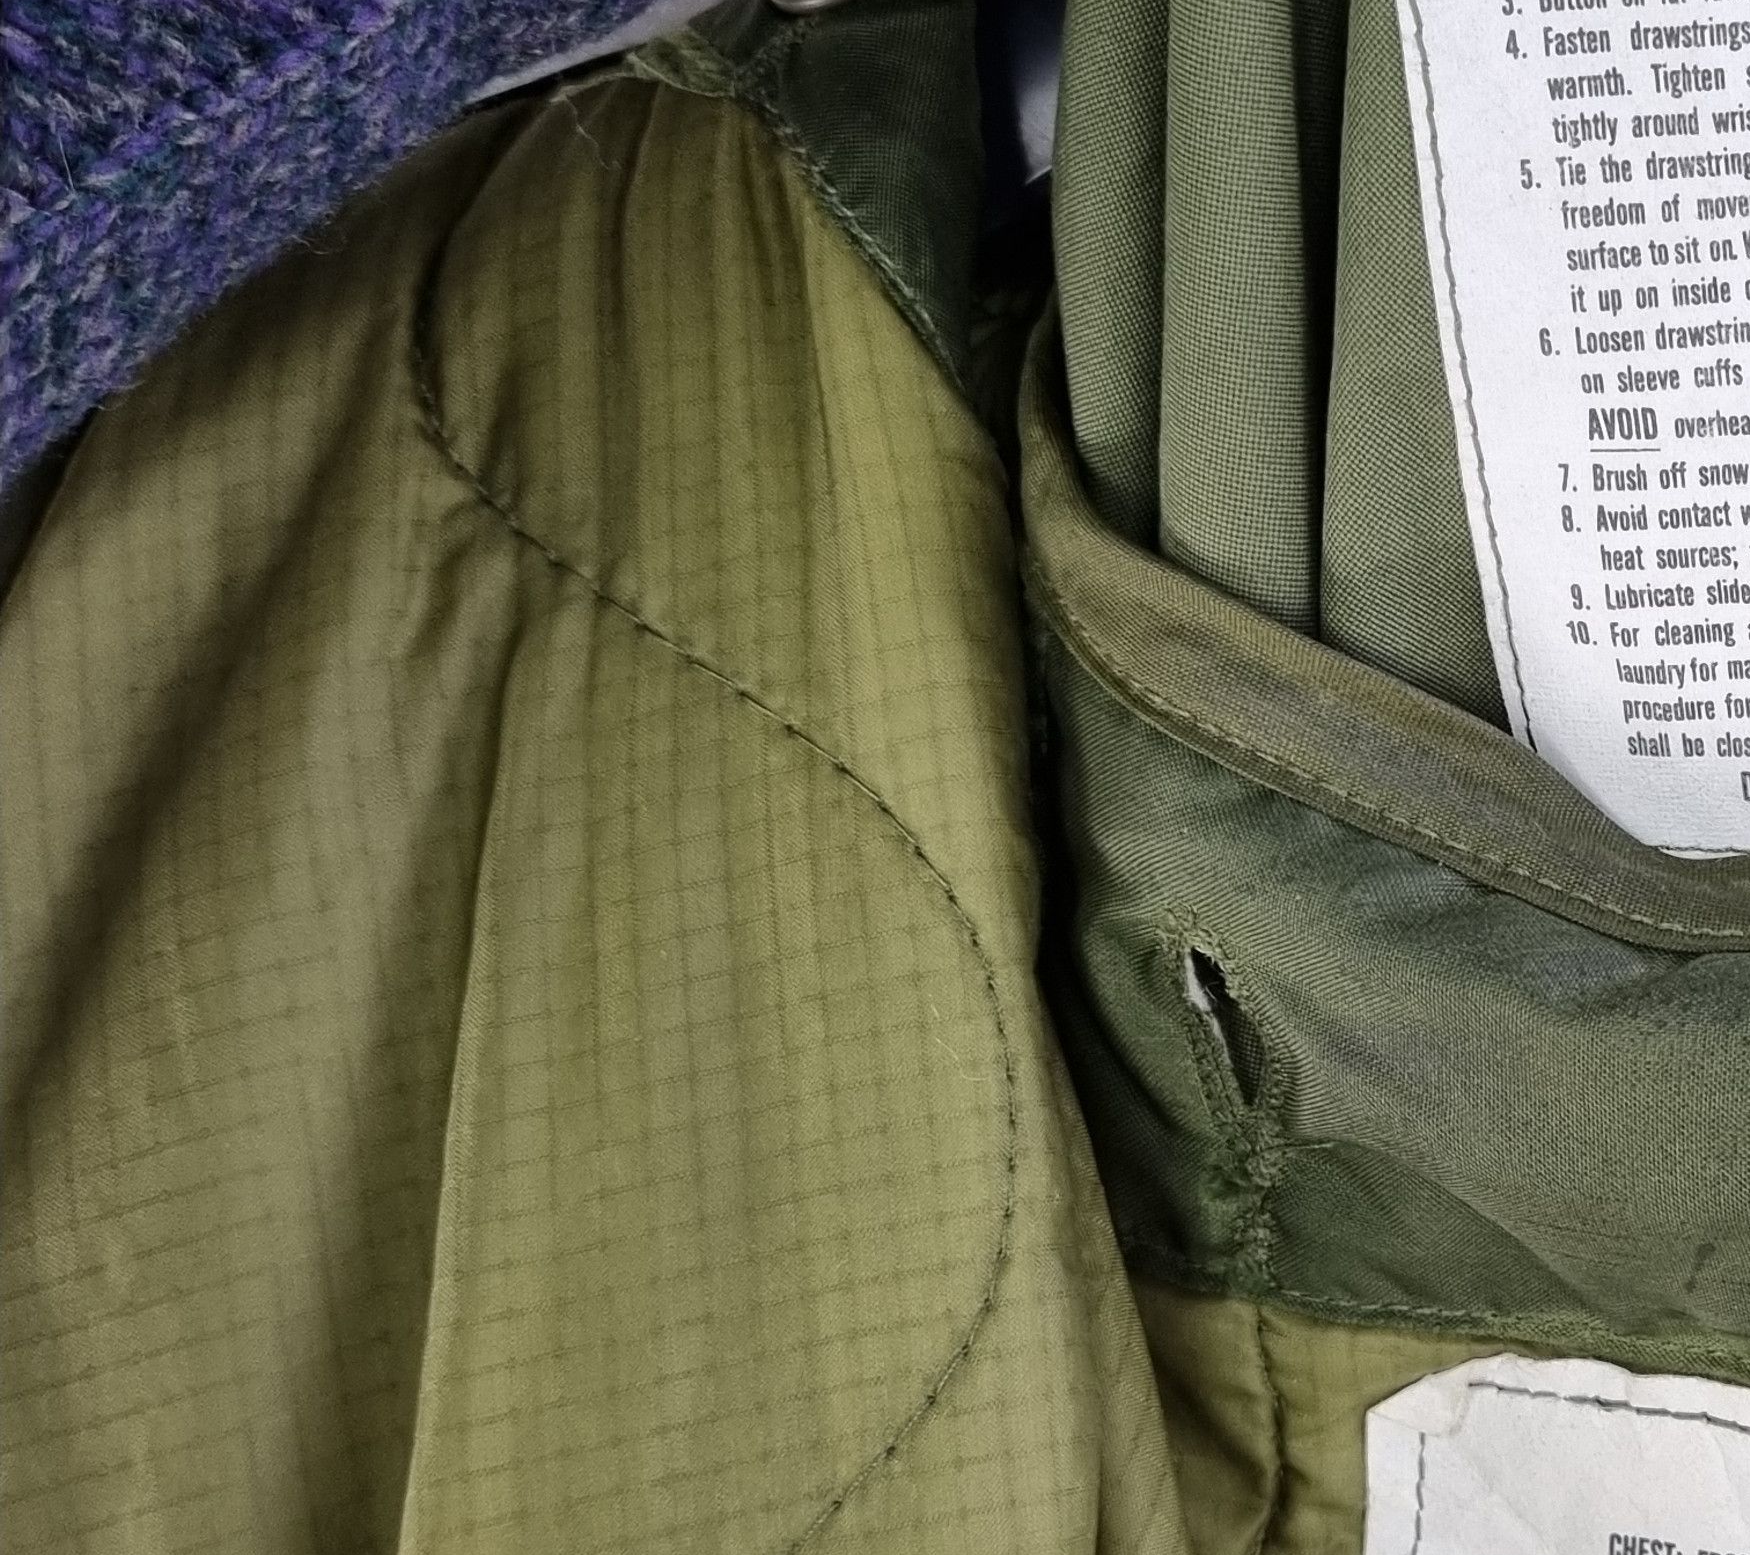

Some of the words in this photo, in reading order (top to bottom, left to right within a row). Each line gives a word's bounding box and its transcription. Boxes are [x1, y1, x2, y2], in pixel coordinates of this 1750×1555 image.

[1538, 327, 1561, 357] 6.
[1574, 326, 1645, 355] Loosen
[1588, 406, 1659, 441] AVOID
[1560, 504, 1582, 533] 8.
[1596, 504, 1649, 533] Avoid
[1657, 501, 1732, 530] contact
[1599, 544, 1645, 572] heat
[1655, 545, 1739, 570] sources;
[1627, 731, 1672, 758] shall
[1681, 732, 1705, 758] be
